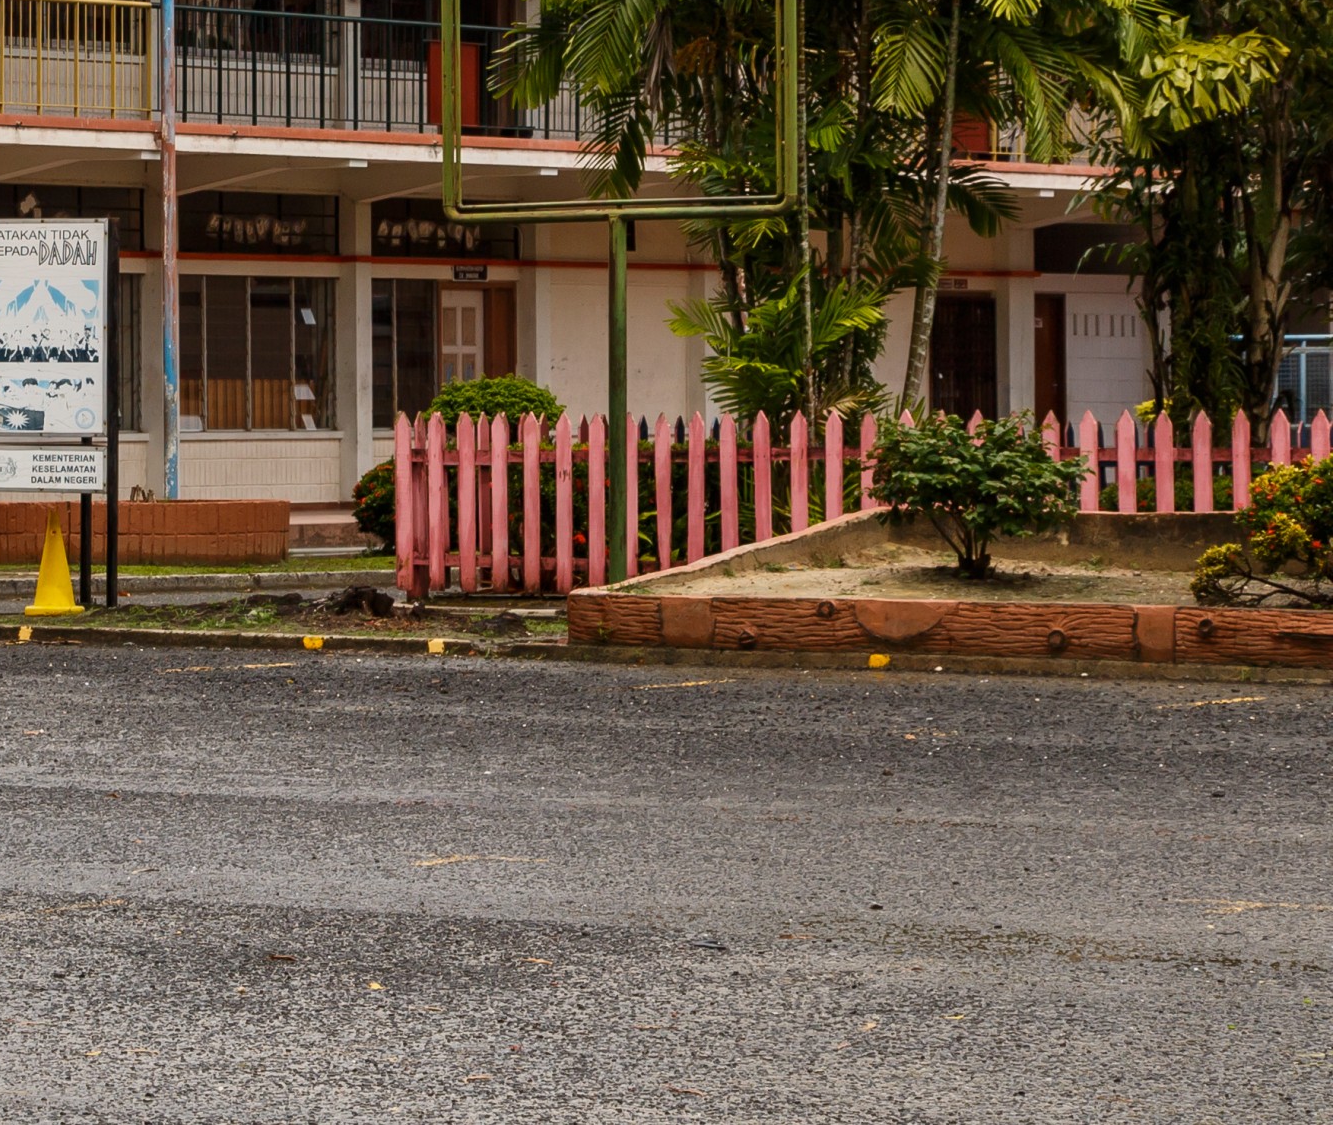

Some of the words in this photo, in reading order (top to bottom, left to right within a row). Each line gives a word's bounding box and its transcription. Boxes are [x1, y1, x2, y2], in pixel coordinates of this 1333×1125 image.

[51, 230, 89, 239] TIDAK
[39, 240, 97, 265] DADAH
[32, 454, 95, 462] KEMENTERIAN
[32, 465, 96, 473] KESELAMATAN
[31, 476, 61, 484] DALAM
[64, 476, 97, 484] NEGERI
